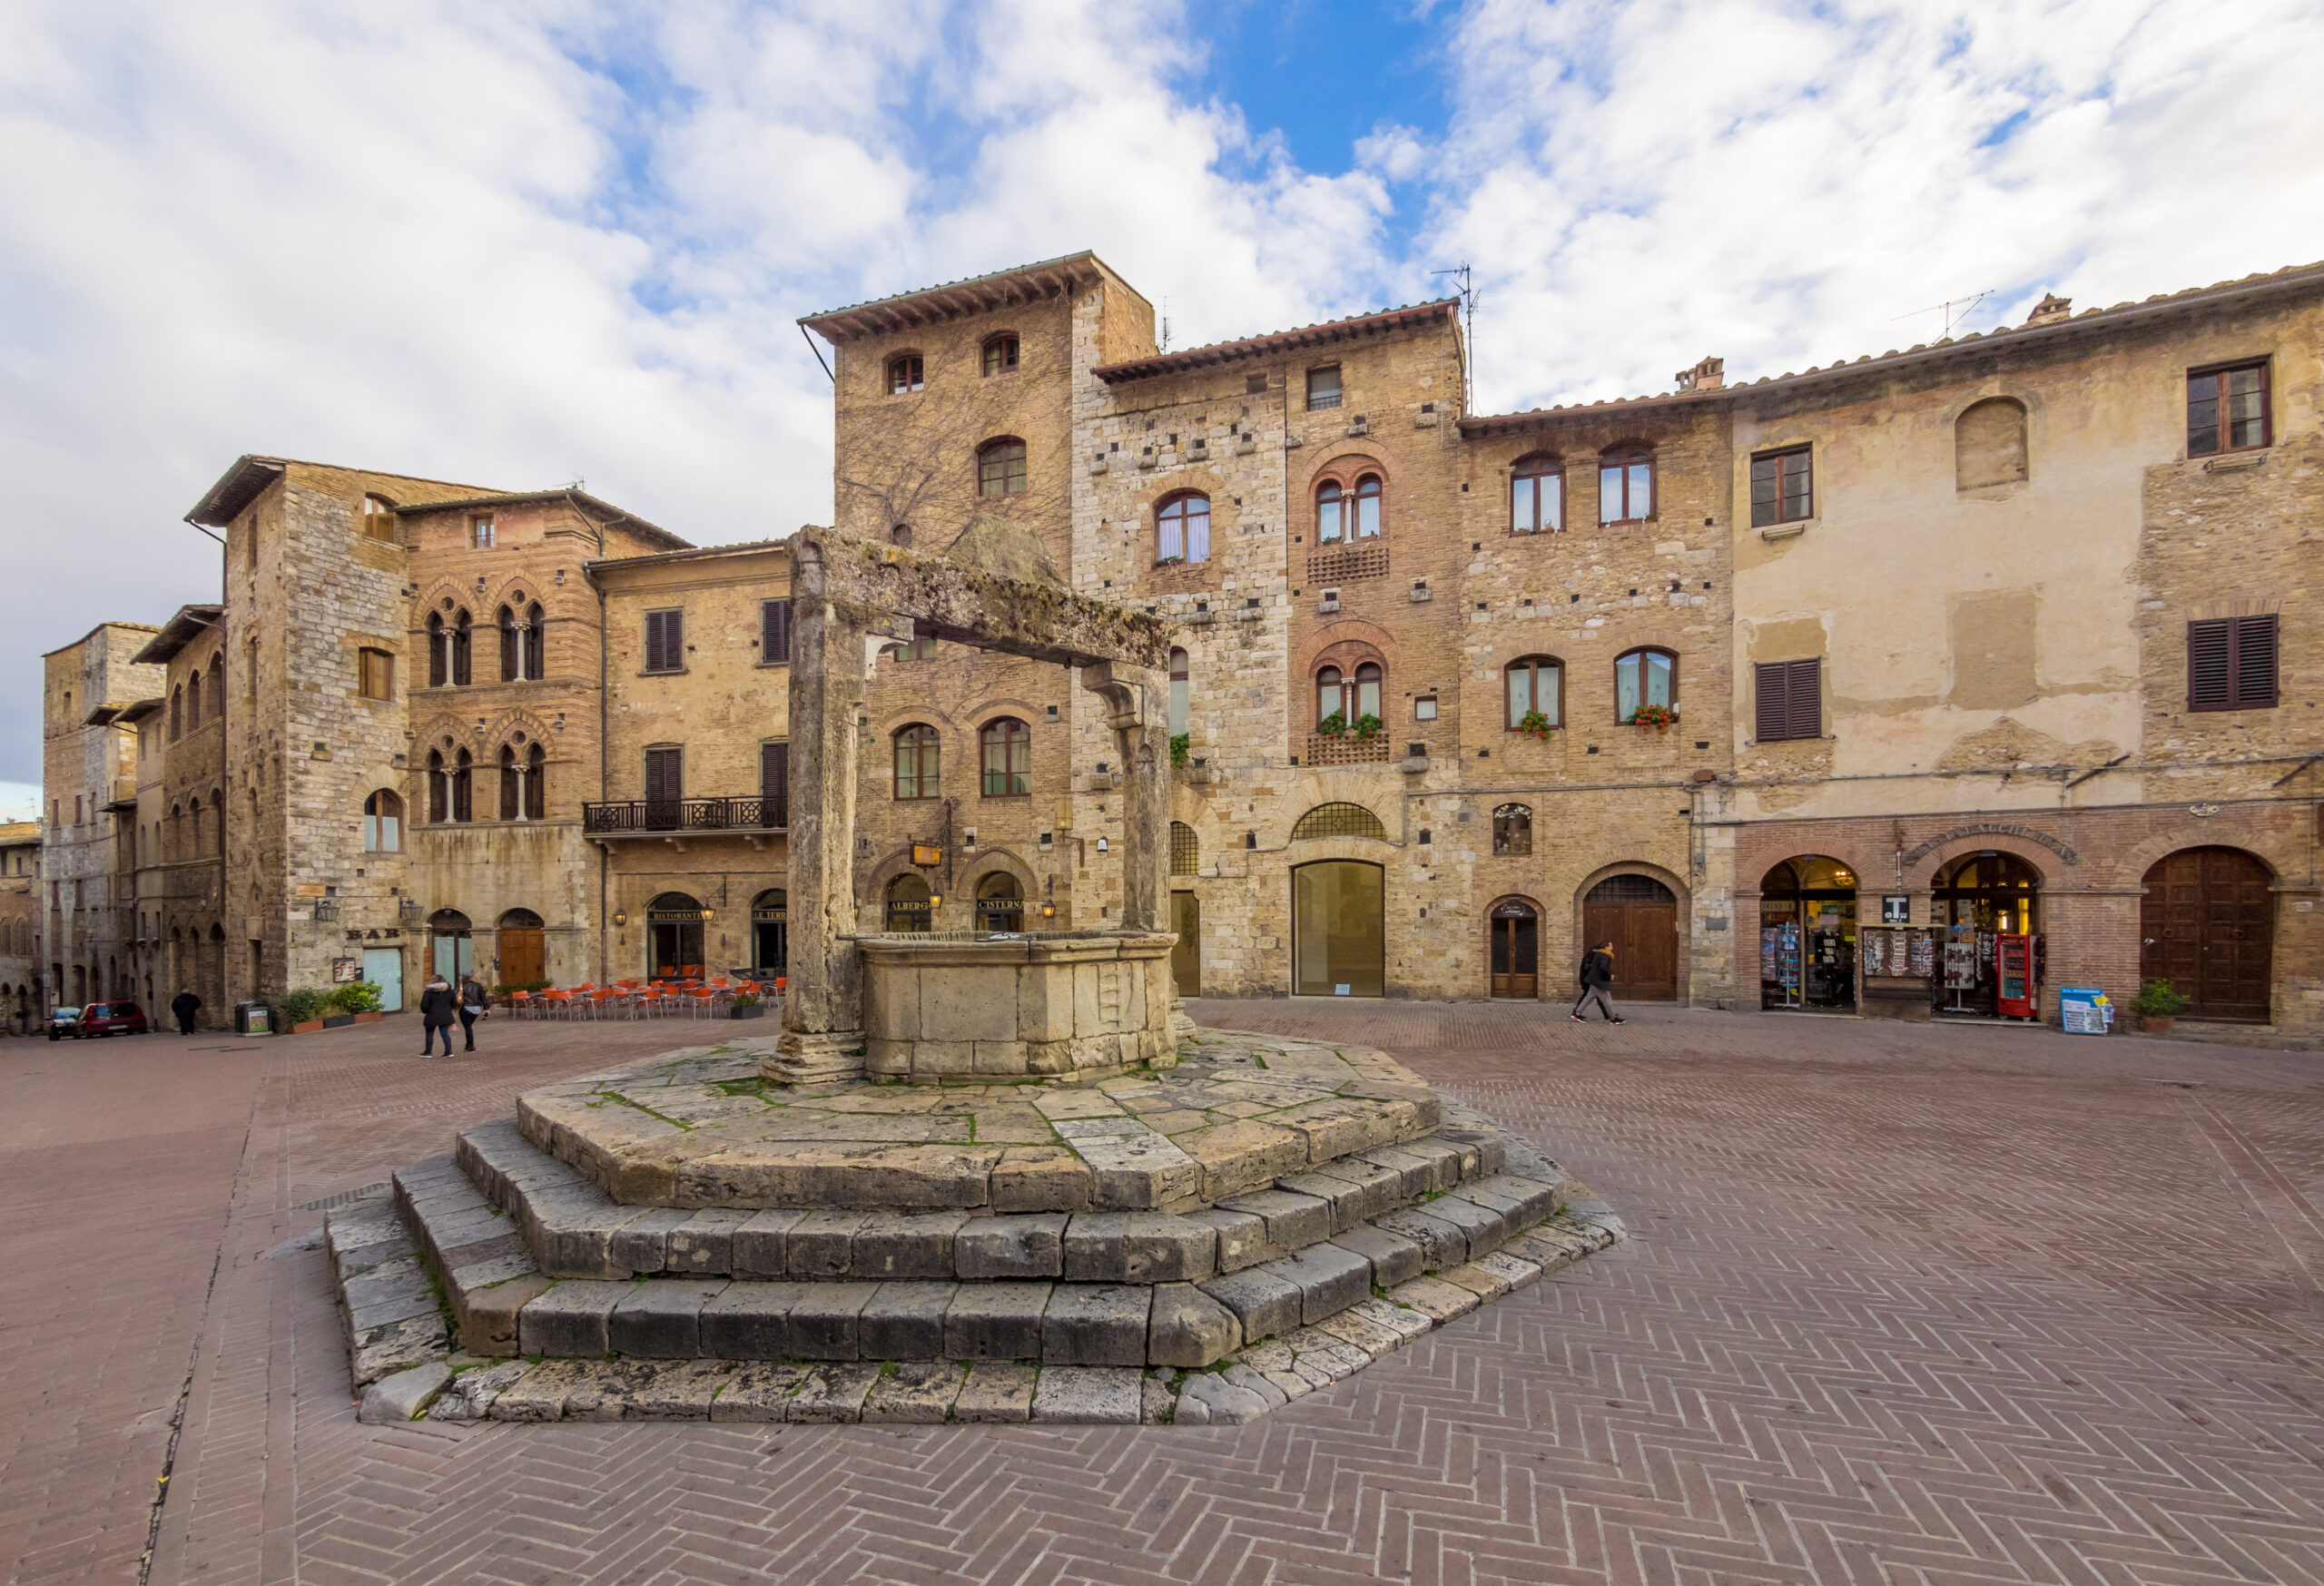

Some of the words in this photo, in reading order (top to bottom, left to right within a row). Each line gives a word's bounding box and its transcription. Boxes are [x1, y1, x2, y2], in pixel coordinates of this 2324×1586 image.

[978, 900, 1024, 909] CISTERNA
[1886, 897, 1906, 919] T
[767, 911, 786, 919] TERR
[346, 929, 399, 941] BAR
